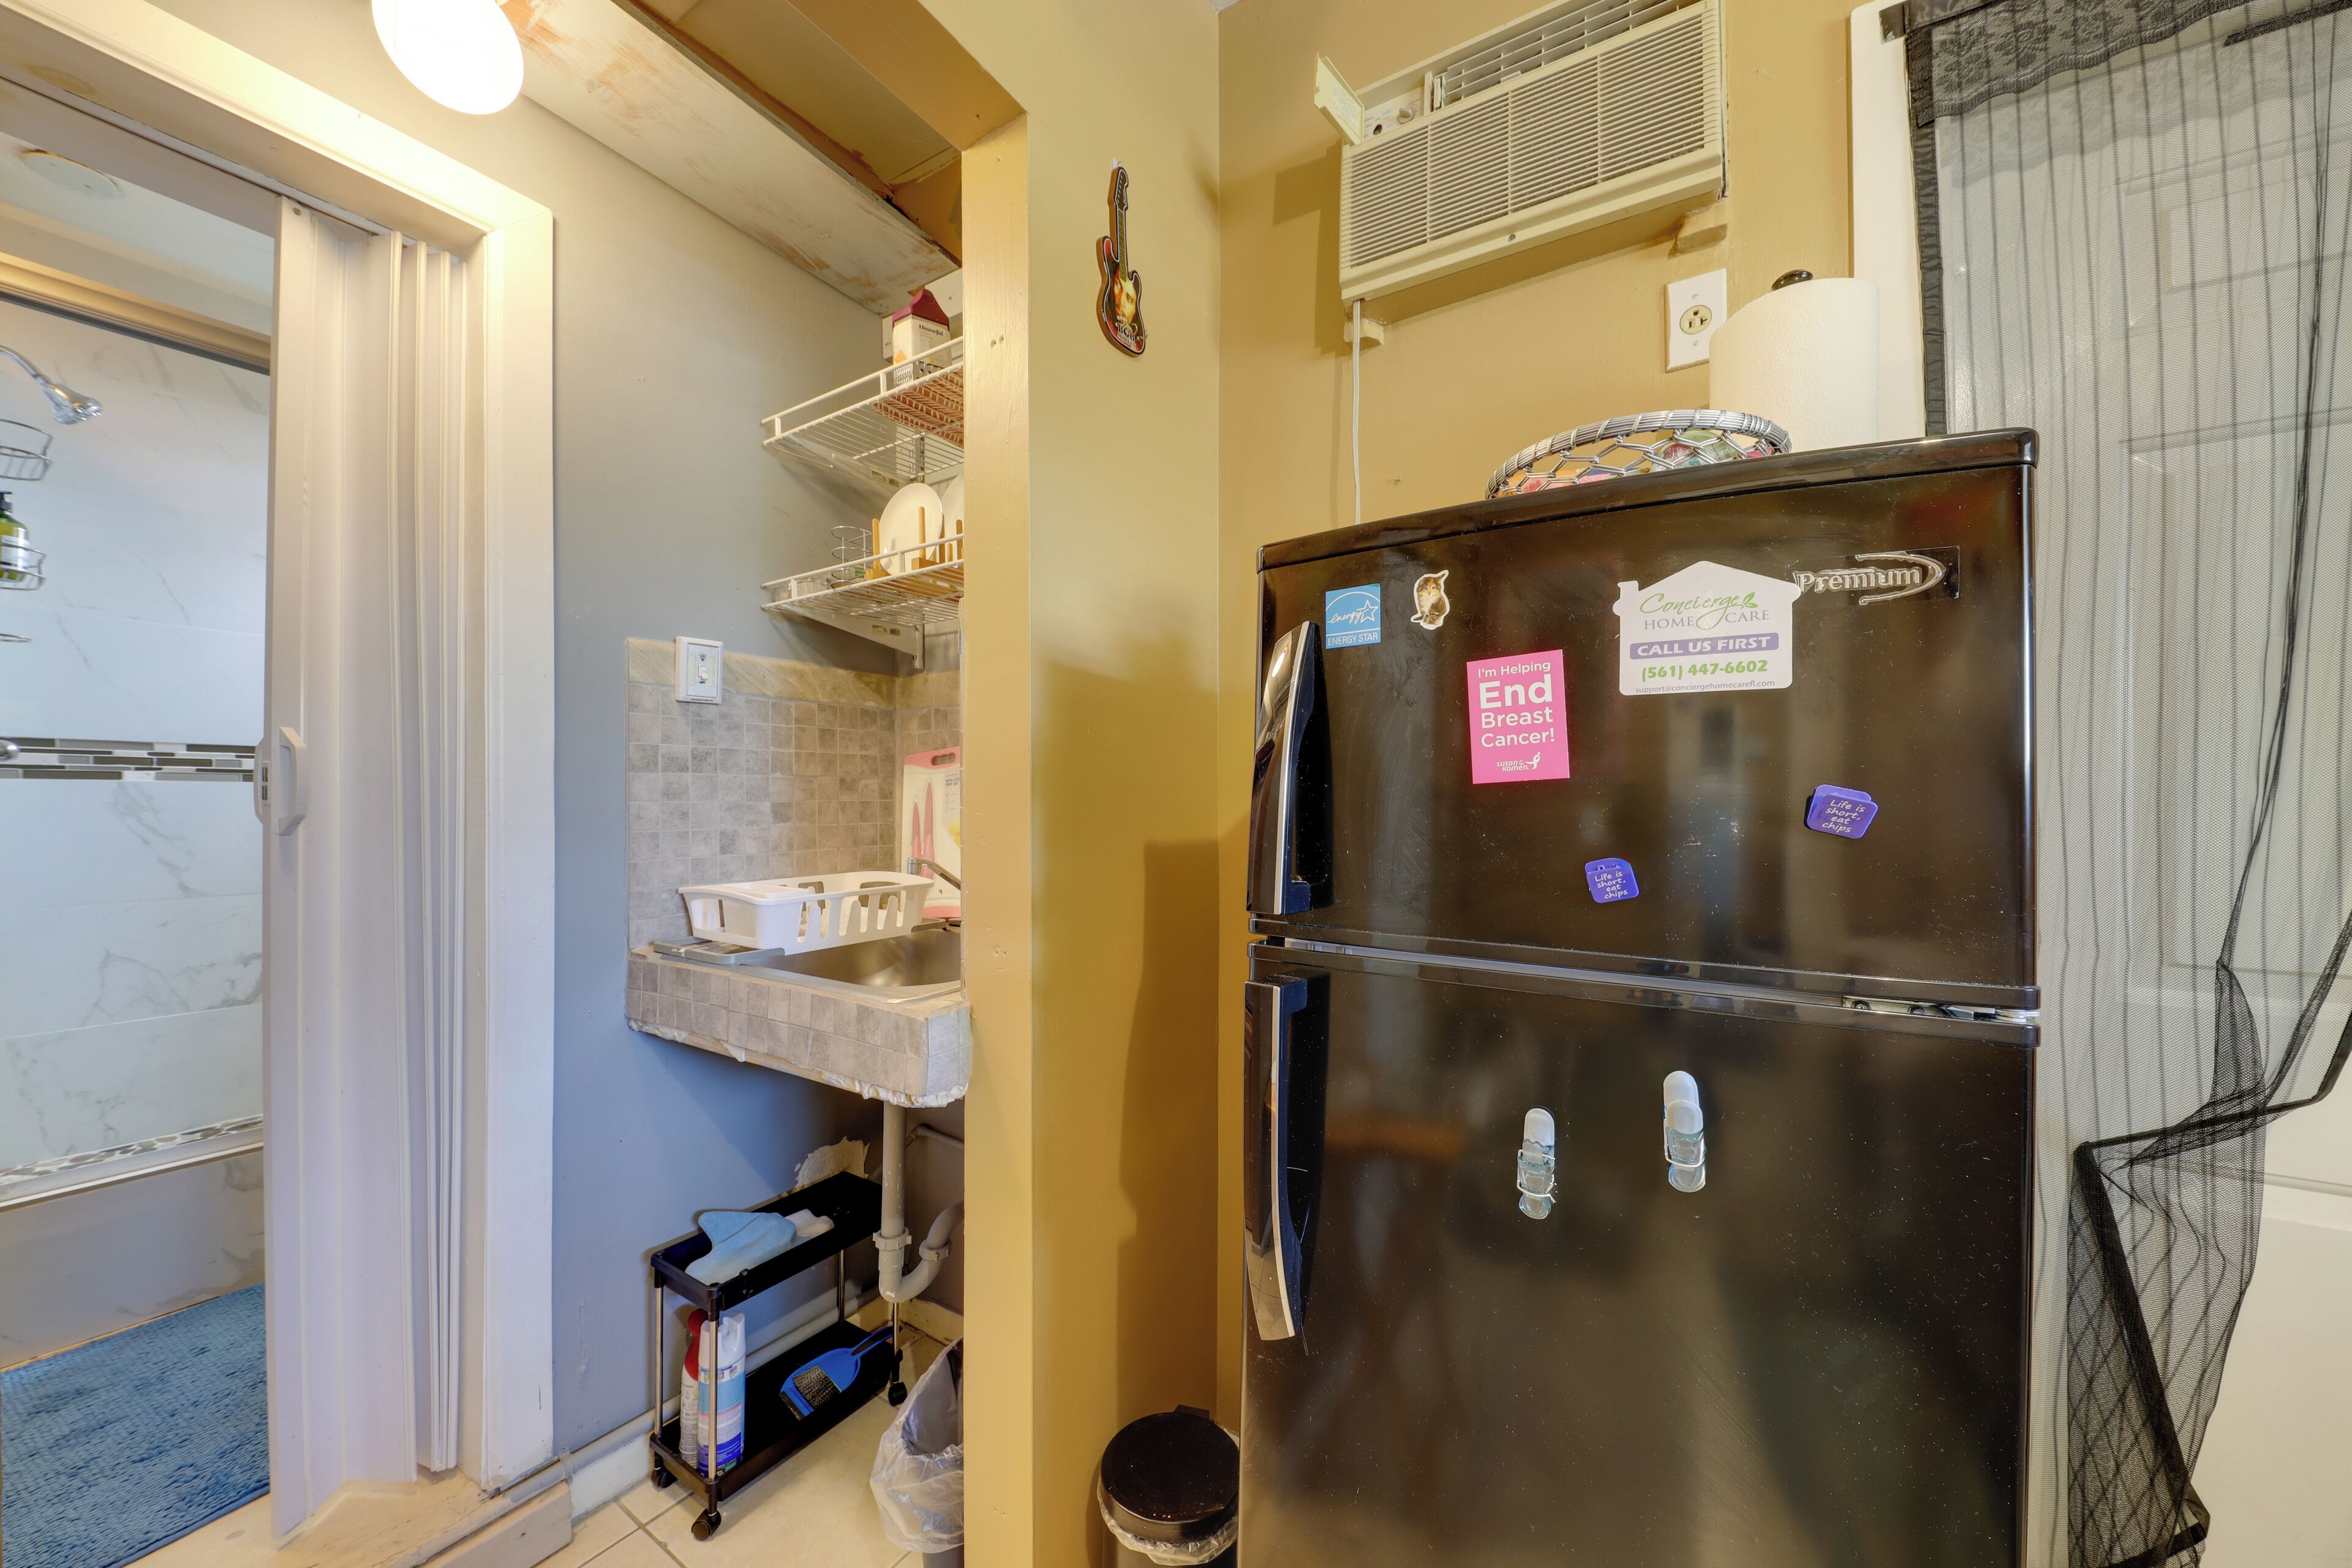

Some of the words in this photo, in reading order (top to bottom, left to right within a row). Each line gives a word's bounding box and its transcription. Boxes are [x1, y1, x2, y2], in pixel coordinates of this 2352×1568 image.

[1795, 567, 1921, 593] Premium
[1327, 609, 1367, 624] energy
[1640, 593, 1744, 630] Concierge
[1644, 616, 1694, 630] HOME
[1725, 609, 1770, 623] CARE
[1327, 635, 1357, 646] ENERGY
[1359, 631, 1378, 643] STAR
[1637, 643, 1684, 657] CALL
[1688, 641, 1713, 653] US
[1717, 636, 1771, 650] FIRST
[1477, 668, 1496, 678] I'm
[1501, 662, 1551, 676] Helping
[1642, 665, 1683, 682] (561)
[1687, 660, 1768, 676] 447-6602
[1479, 673, 1553, 709] End
[1635, 679, 1776, 694] support@conciergehomecarefl.com
[1480, 706, 1554, 729] Breast
[1480, 727, 1556, 748] Cancer!
[1830, 799, 1852, 810] Life
[1855, 804, 1866, 813] is
[1825, 807, 1861, 821] short,
[1831, 815, 1851, 824] eat
[1822, 822, 1852, 833] chips
[1594, 873, 1613, 882] Life
[1597, 877, 1626, 889] short,
[1604, 889, 1628, 899] chips
